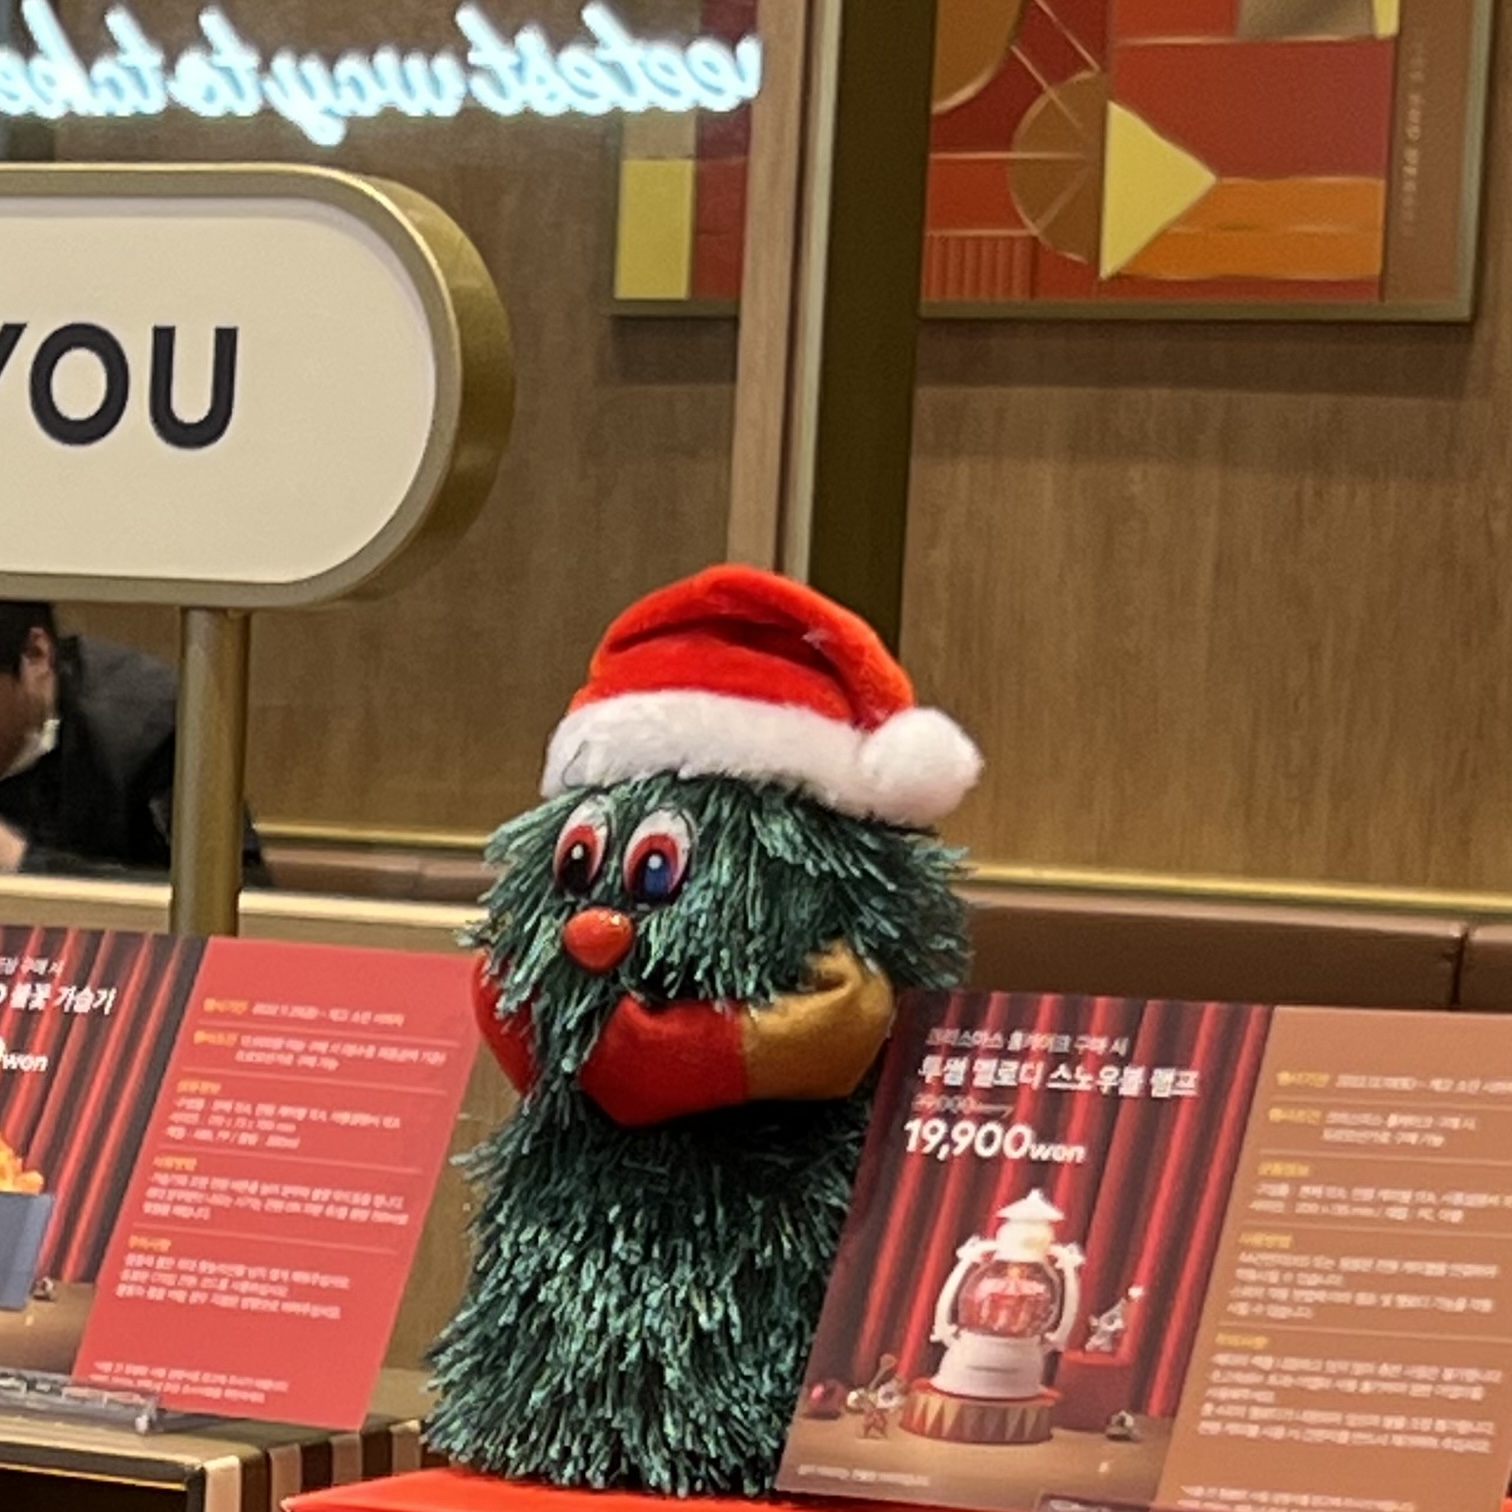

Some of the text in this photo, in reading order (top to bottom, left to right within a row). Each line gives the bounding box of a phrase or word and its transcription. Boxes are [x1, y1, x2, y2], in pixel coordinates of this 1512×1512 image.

[53, 985, 117, 1015] 가습기
[918, 1054, 1200, 1099] 투썸 멜로디 스노우볼 램프
[904, 1117, 1086, 1163] 19,900won
